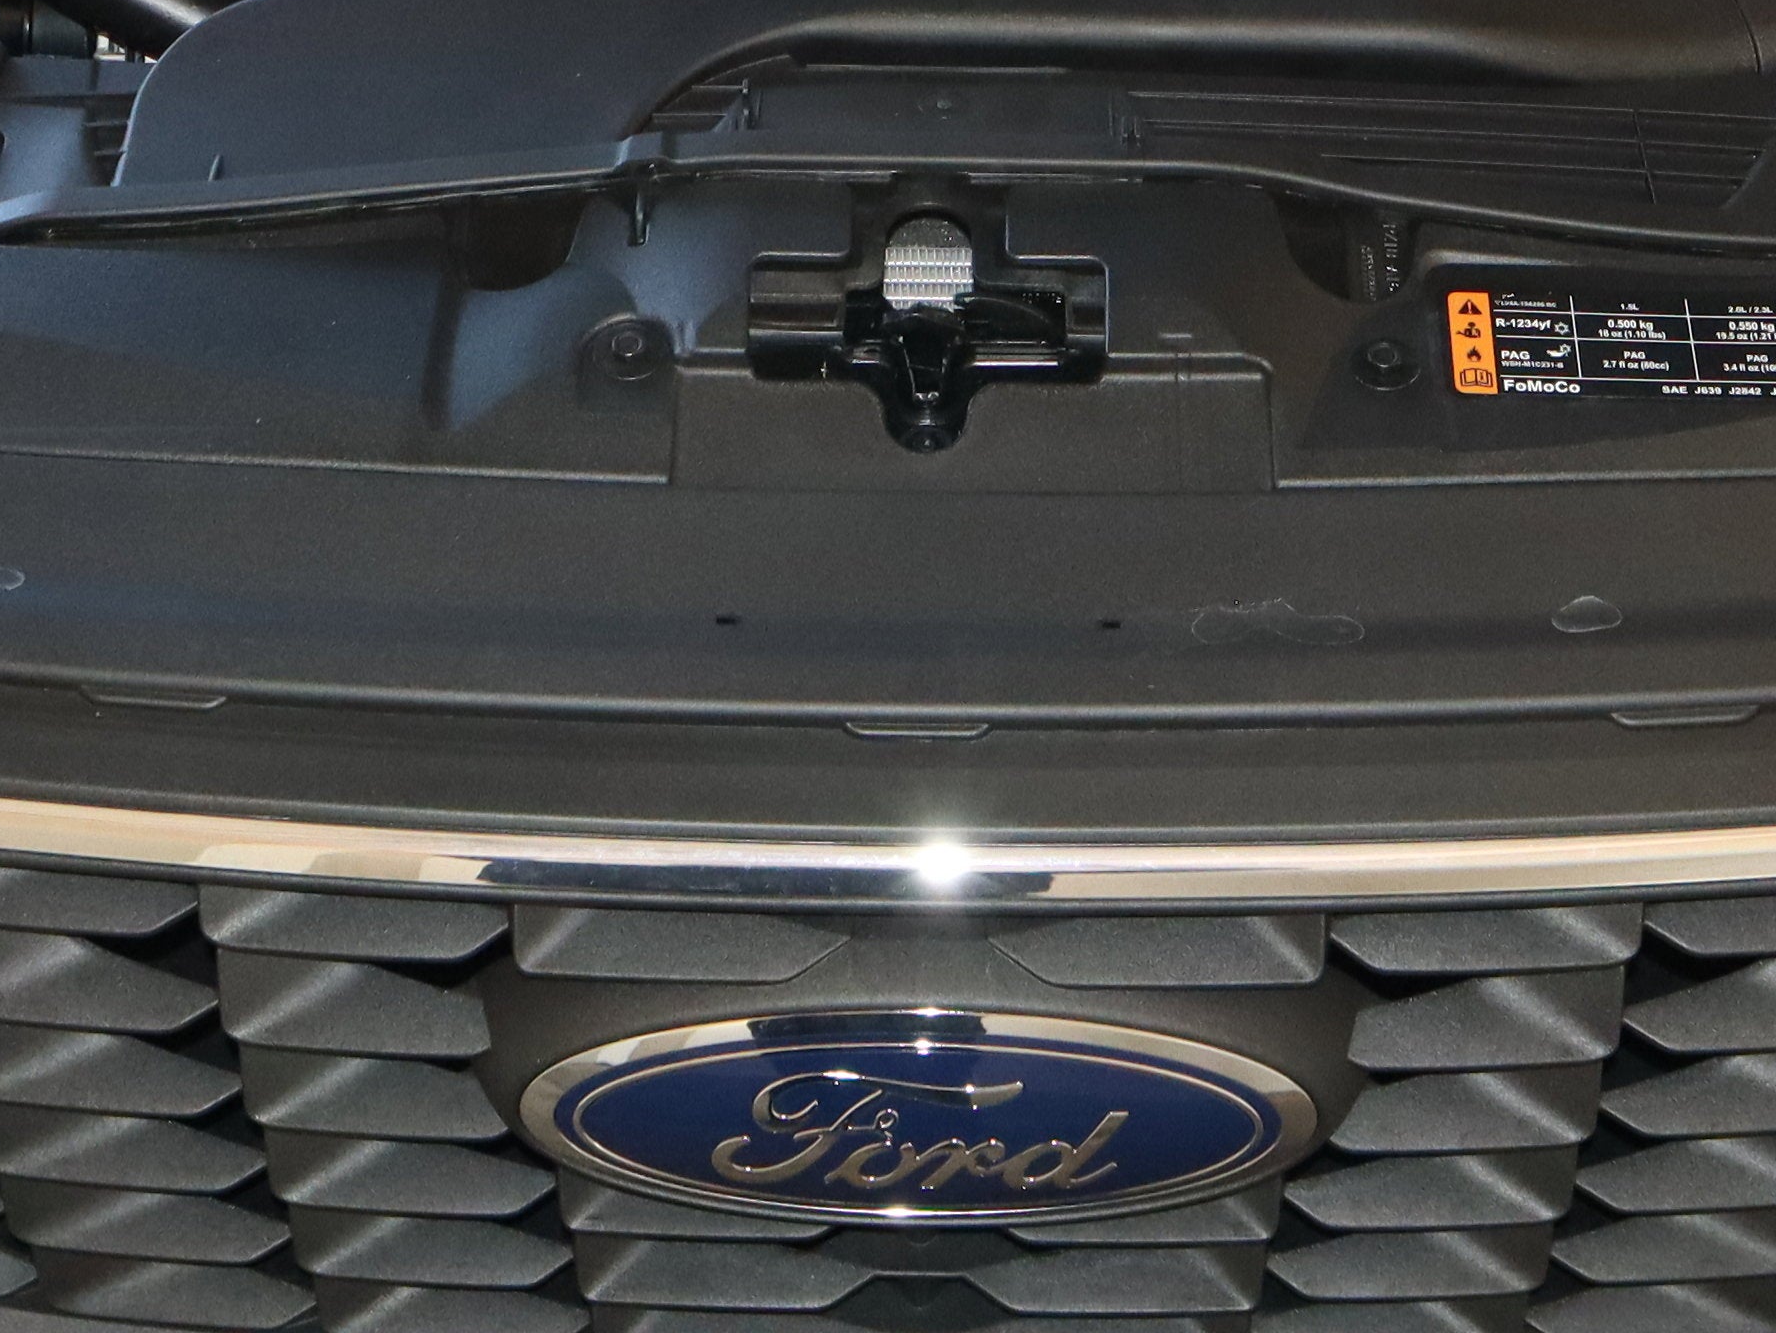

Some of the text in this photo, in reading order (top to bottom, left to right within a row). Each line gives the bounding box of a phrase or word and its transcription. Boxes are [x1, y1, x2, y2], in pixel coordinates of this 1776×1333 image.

[1620, 303, 1640, 311] 1.5L
[1495, 318, 1551, 331] R-1234yf
[1607, 319, 1654, 331] 0.500 kg
[1728, 321, 1775, 333] 0.550 kg
[1624, 330, 1647, 340] (1.10
[1648, 330, 1666, 340] lbs)
[1715, 332, 1736, 340] 19.5
[1750, 332, 1772, 342] (1.21
[1501, 350, 1530, 360] PAG
[1623, 351, 1646, 359] PAG
[1746, 354, 1769, 363] PAG
[1603, 360, 1617, 368] 2.7
[1723, 363, 1737, 371] 3.4
[1503, 379, 1581, 393] FoMoCo
[1661, 385, 1688, 394] SAE
[709, 1070, 1130, 1191] Ford
